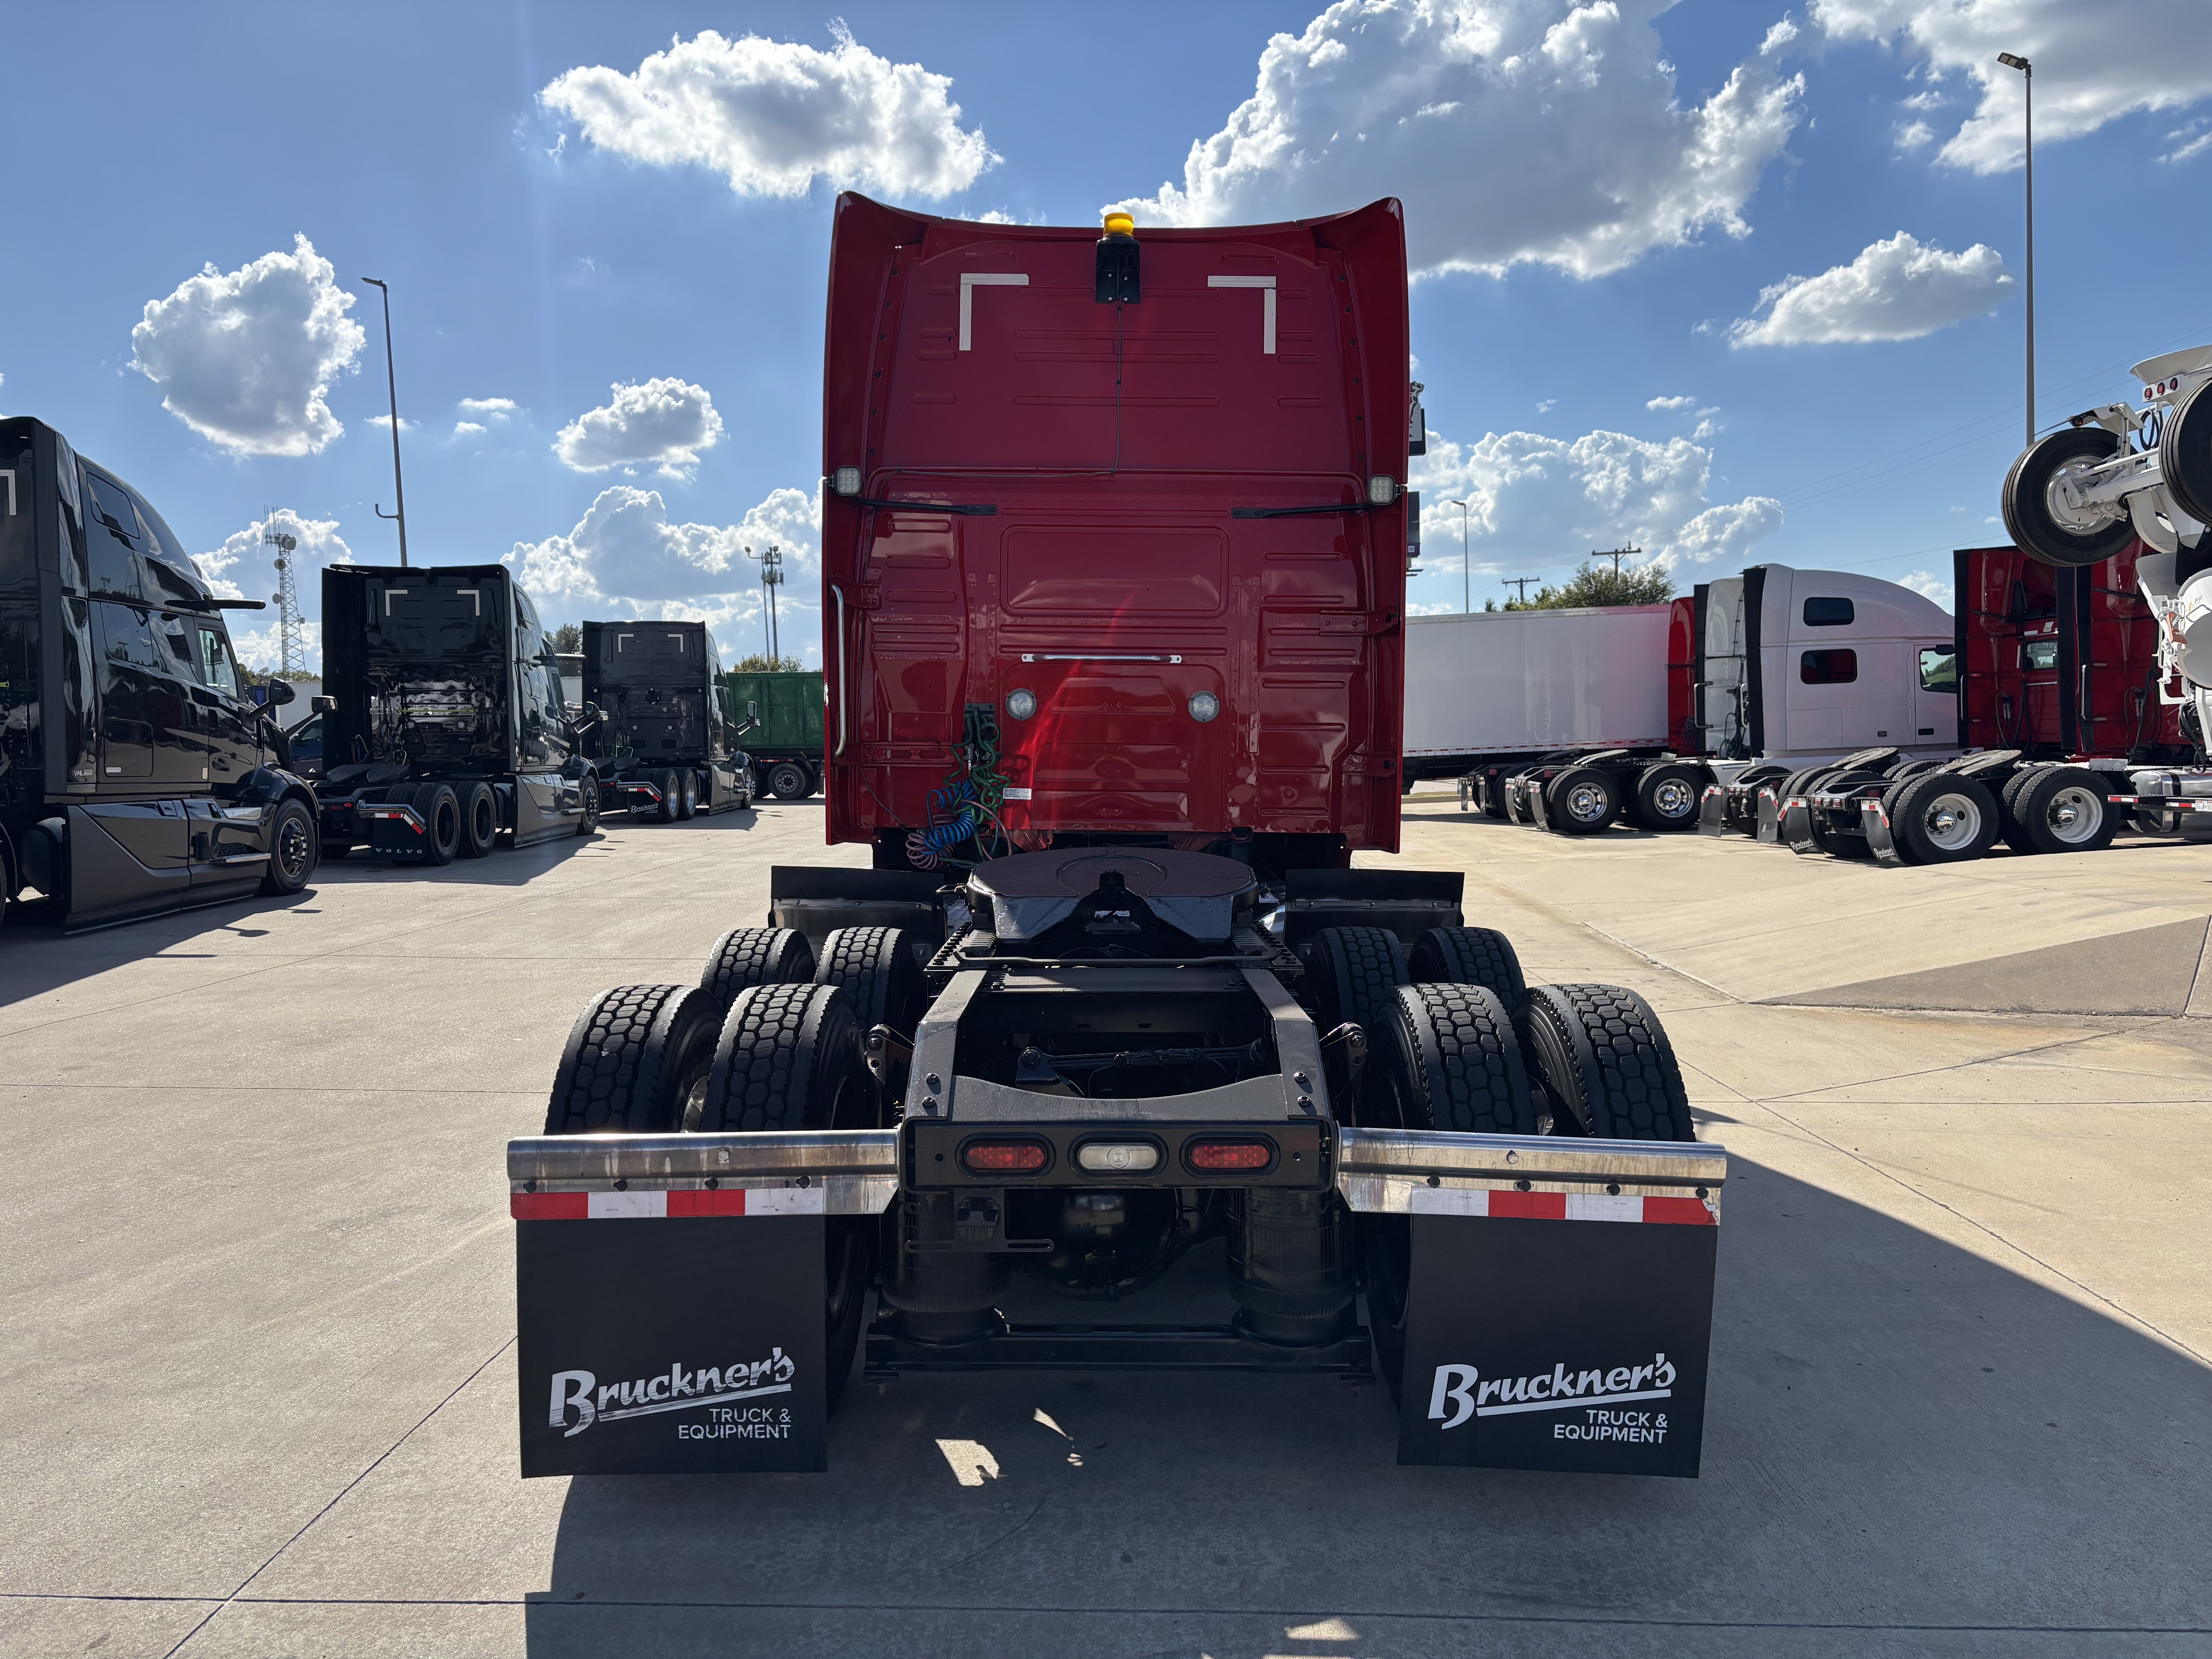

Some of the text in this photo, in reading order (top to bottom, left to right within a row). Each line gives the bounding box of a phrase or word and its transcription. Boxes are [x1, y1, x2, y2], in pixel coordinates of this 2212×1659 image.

[549, 1347, 795, 1437] Bruckner's
[1428, 1353, 1676, 1430] Bruckner's
[709, 1408, 792, 1422] TRUCK &
[1586, 1410, 1668, 1428] TRUCK &
[678, 1424, 791, 1439] EQUIPMENT
[1554, 1424, 1667, 1444] EQUIPMENT
